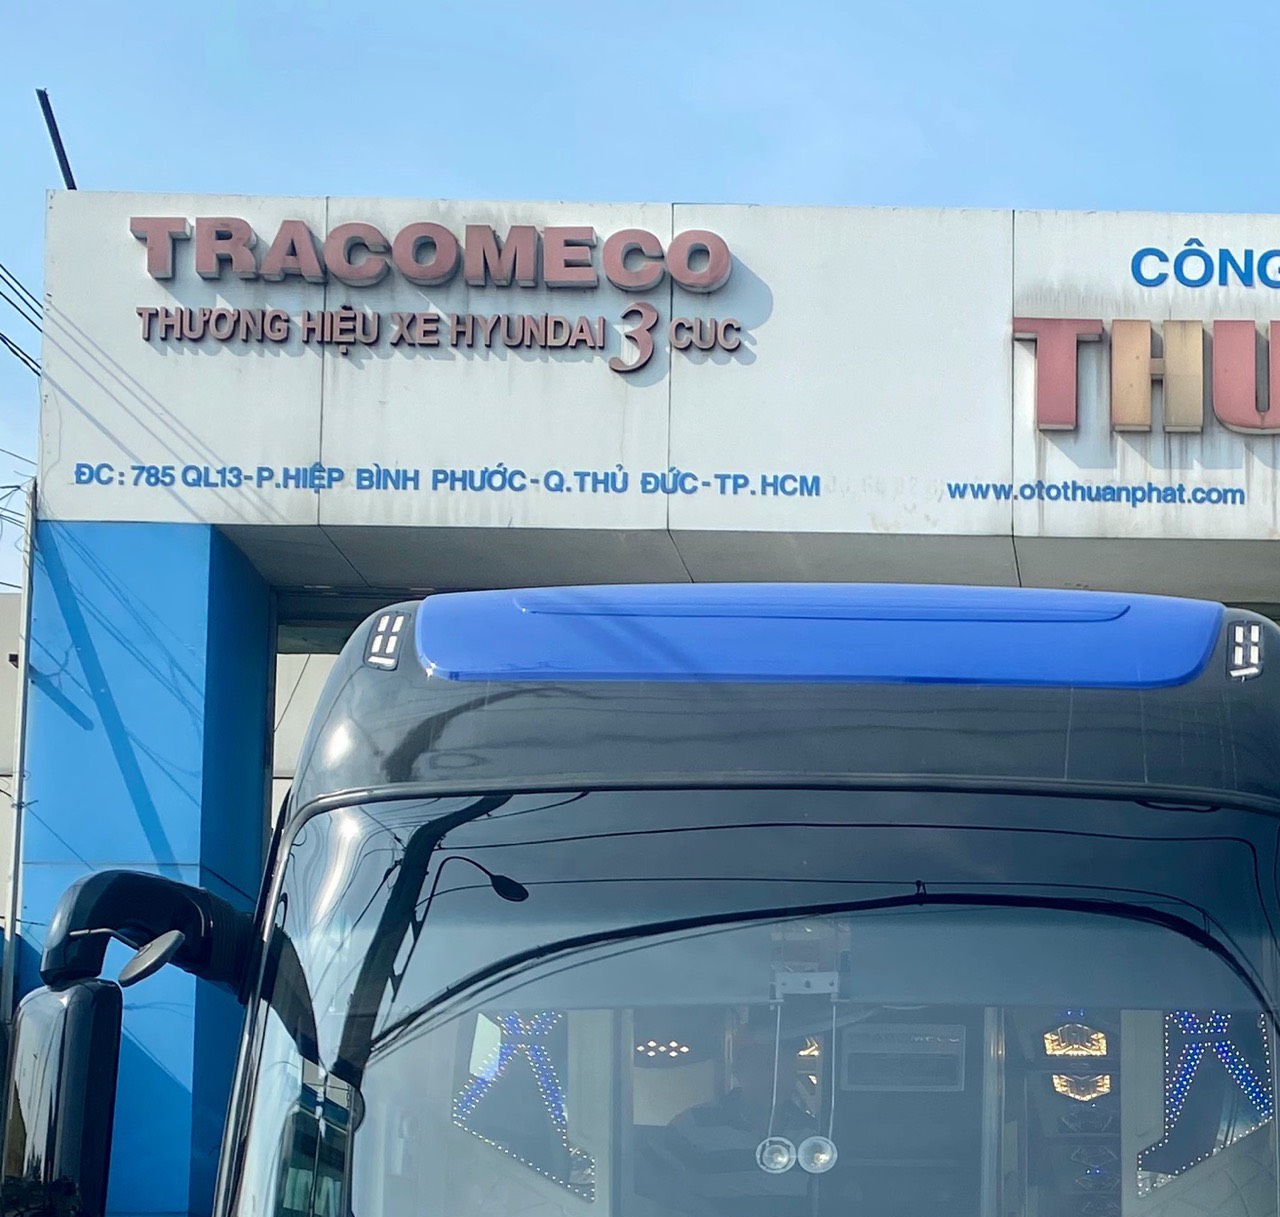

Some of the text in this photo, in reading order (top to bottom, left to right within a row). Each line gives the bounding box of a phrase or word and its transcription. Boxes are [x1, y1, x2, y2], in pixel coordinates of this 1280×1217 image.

[129, 216, 733, 293] TRACOMECO
[136, 306, 290, 342] THƯƠNG
[301, 304, 380, 355] HIỆU
[390, 312, 440, 347] XE
[450, 312, 607, 349] HYUNDAI
[608, 301, 660, 373] 3
[131, 465, 176, 487] 785
[355, 462, 420, 490] BÌNH
[947, 480, 1246, 507] www.otothuanphat.com
